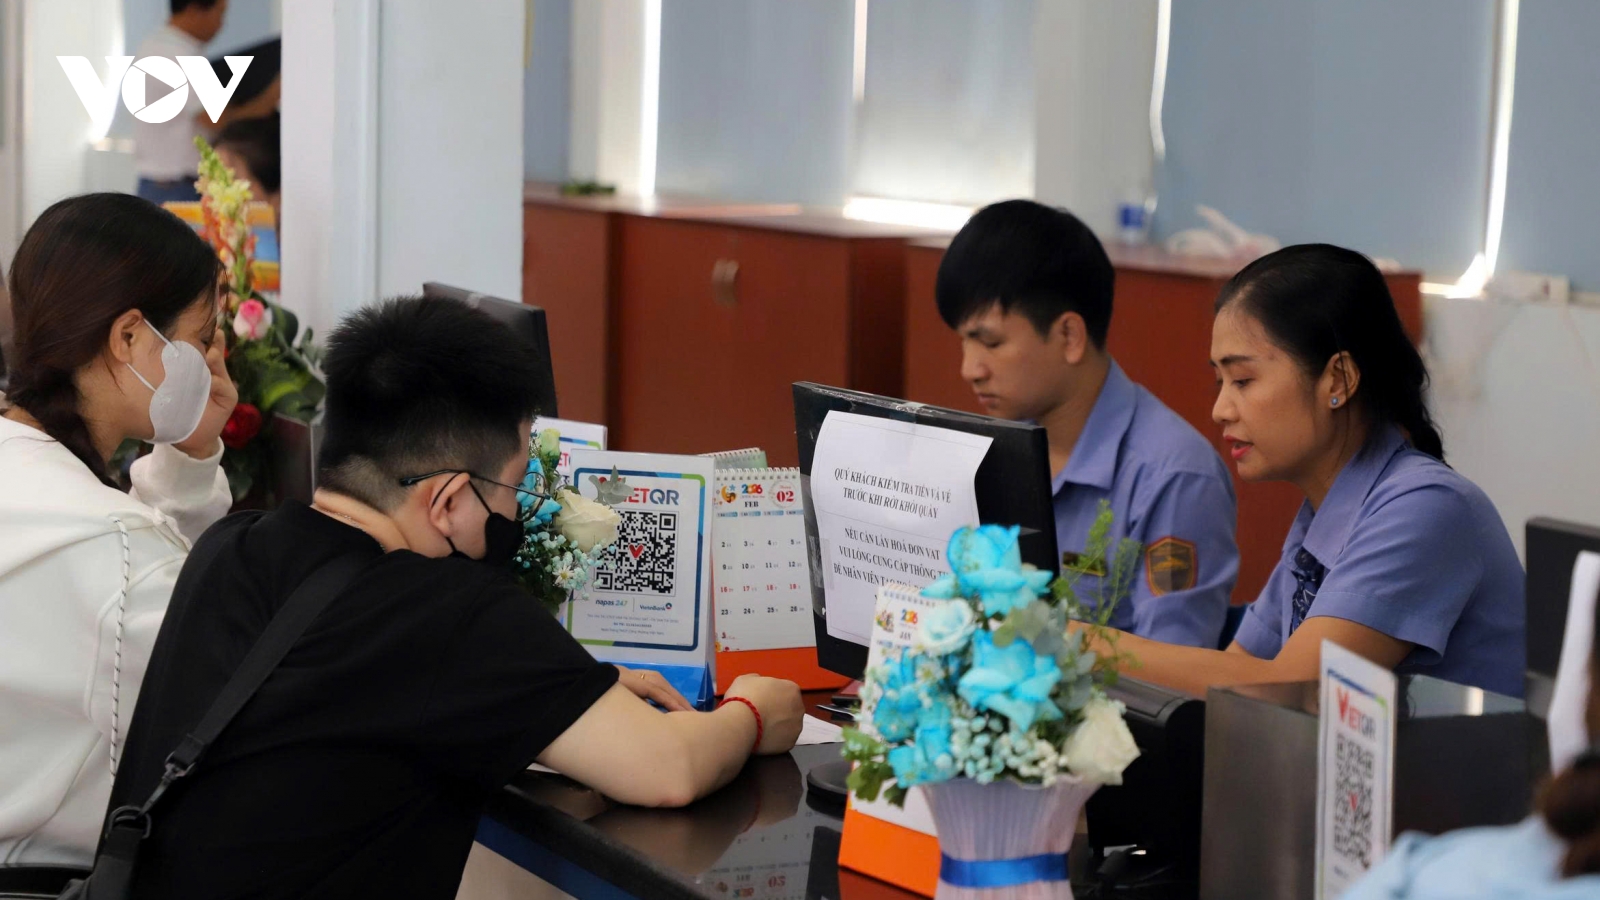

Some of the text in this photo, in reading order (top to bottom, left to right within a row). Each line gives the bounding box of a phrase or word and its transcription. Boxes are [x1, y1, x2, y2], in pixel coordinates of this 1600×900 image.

[598, 477, 680, 506] ETQR
[834, 467, 850, 481] QUÝ
[851, 469, 877, 486] KHÁCH
[901, 482, 913, 495] TRA
[776, 490, 794, 502] 02
[843, 486, 868, 502] TRƯỚC
[868, 493, 882, 506] KHI
[845, 526, 858, 540] NẾU
[925, 547, 940, 560] VAT
[839, 545, 851, 558] VUI
[852, 548, 872, 563] LÒNG
[872, 554, 893, 569] CUNG
[909, 563, 937, 580] THÔNG
[843, 566, 862, 580] NHÂN
[595, 599, 614, 607] napas
[1336, 686, 1376, 740] VIETQR
